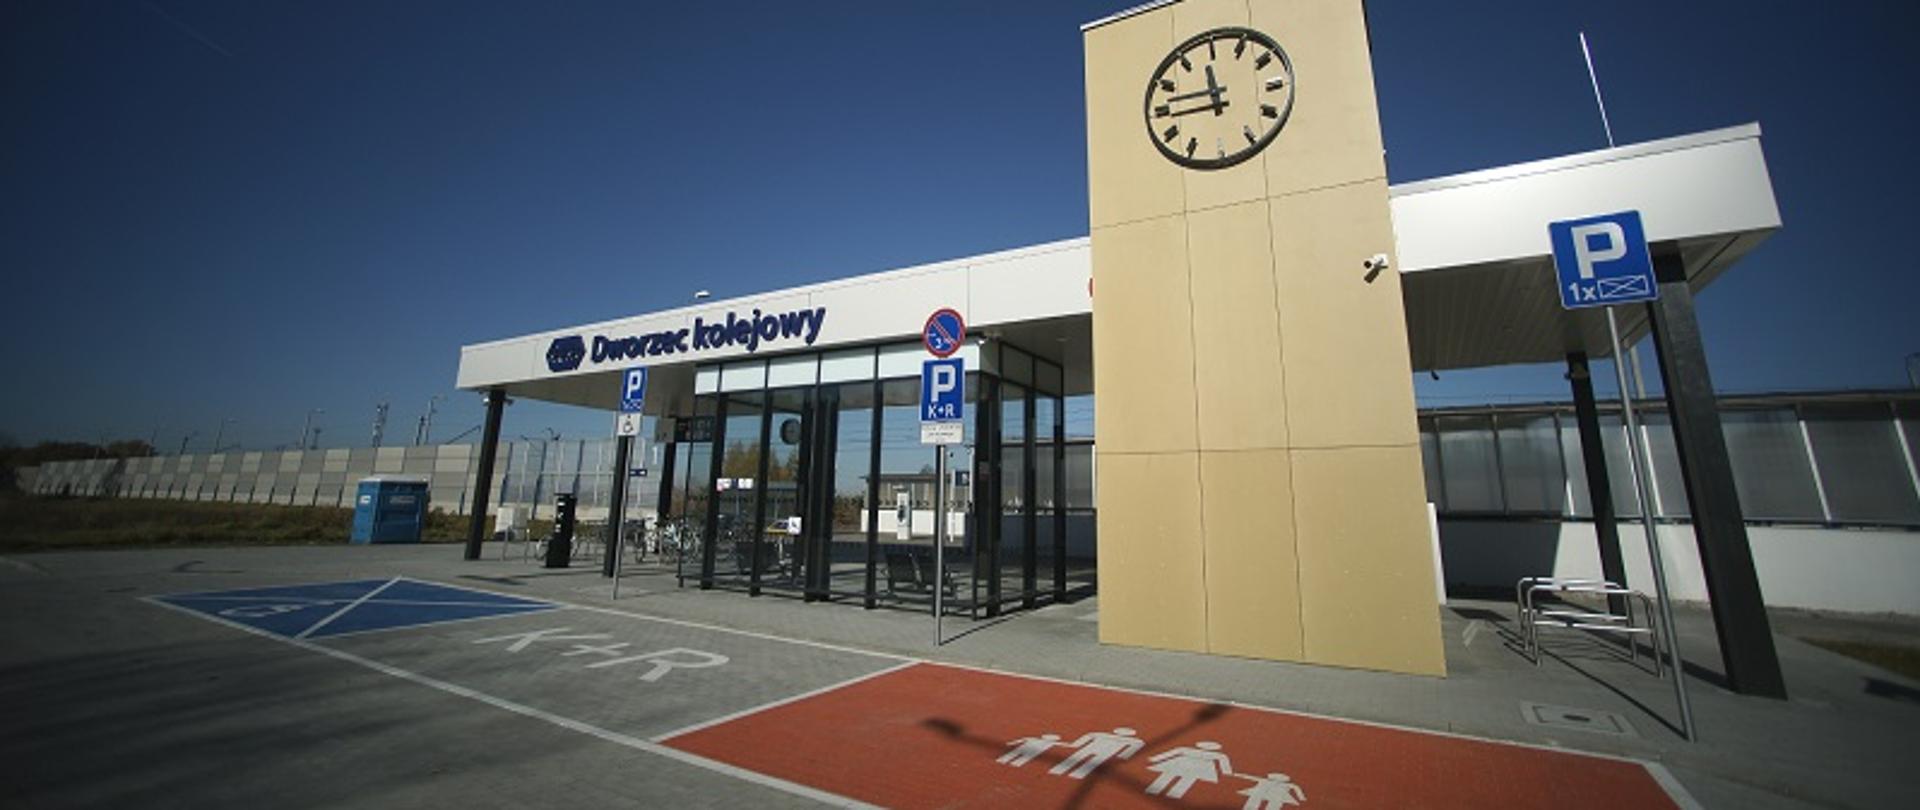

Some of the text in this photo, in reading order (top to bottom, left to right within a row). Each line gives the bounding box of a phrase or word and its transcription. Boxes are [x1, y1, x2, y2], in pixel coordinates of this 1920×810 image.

[1571, 222, 1627, 278] P
[591, 329, 689, 363] Dworzec
[693, 308, 826, 351] kolejowy
[627, 369, 643, 399] P
[931, 365, 956, 402] P
[928, 403, 955, 419] K+R
[472, 628, 729, 682] K+R
